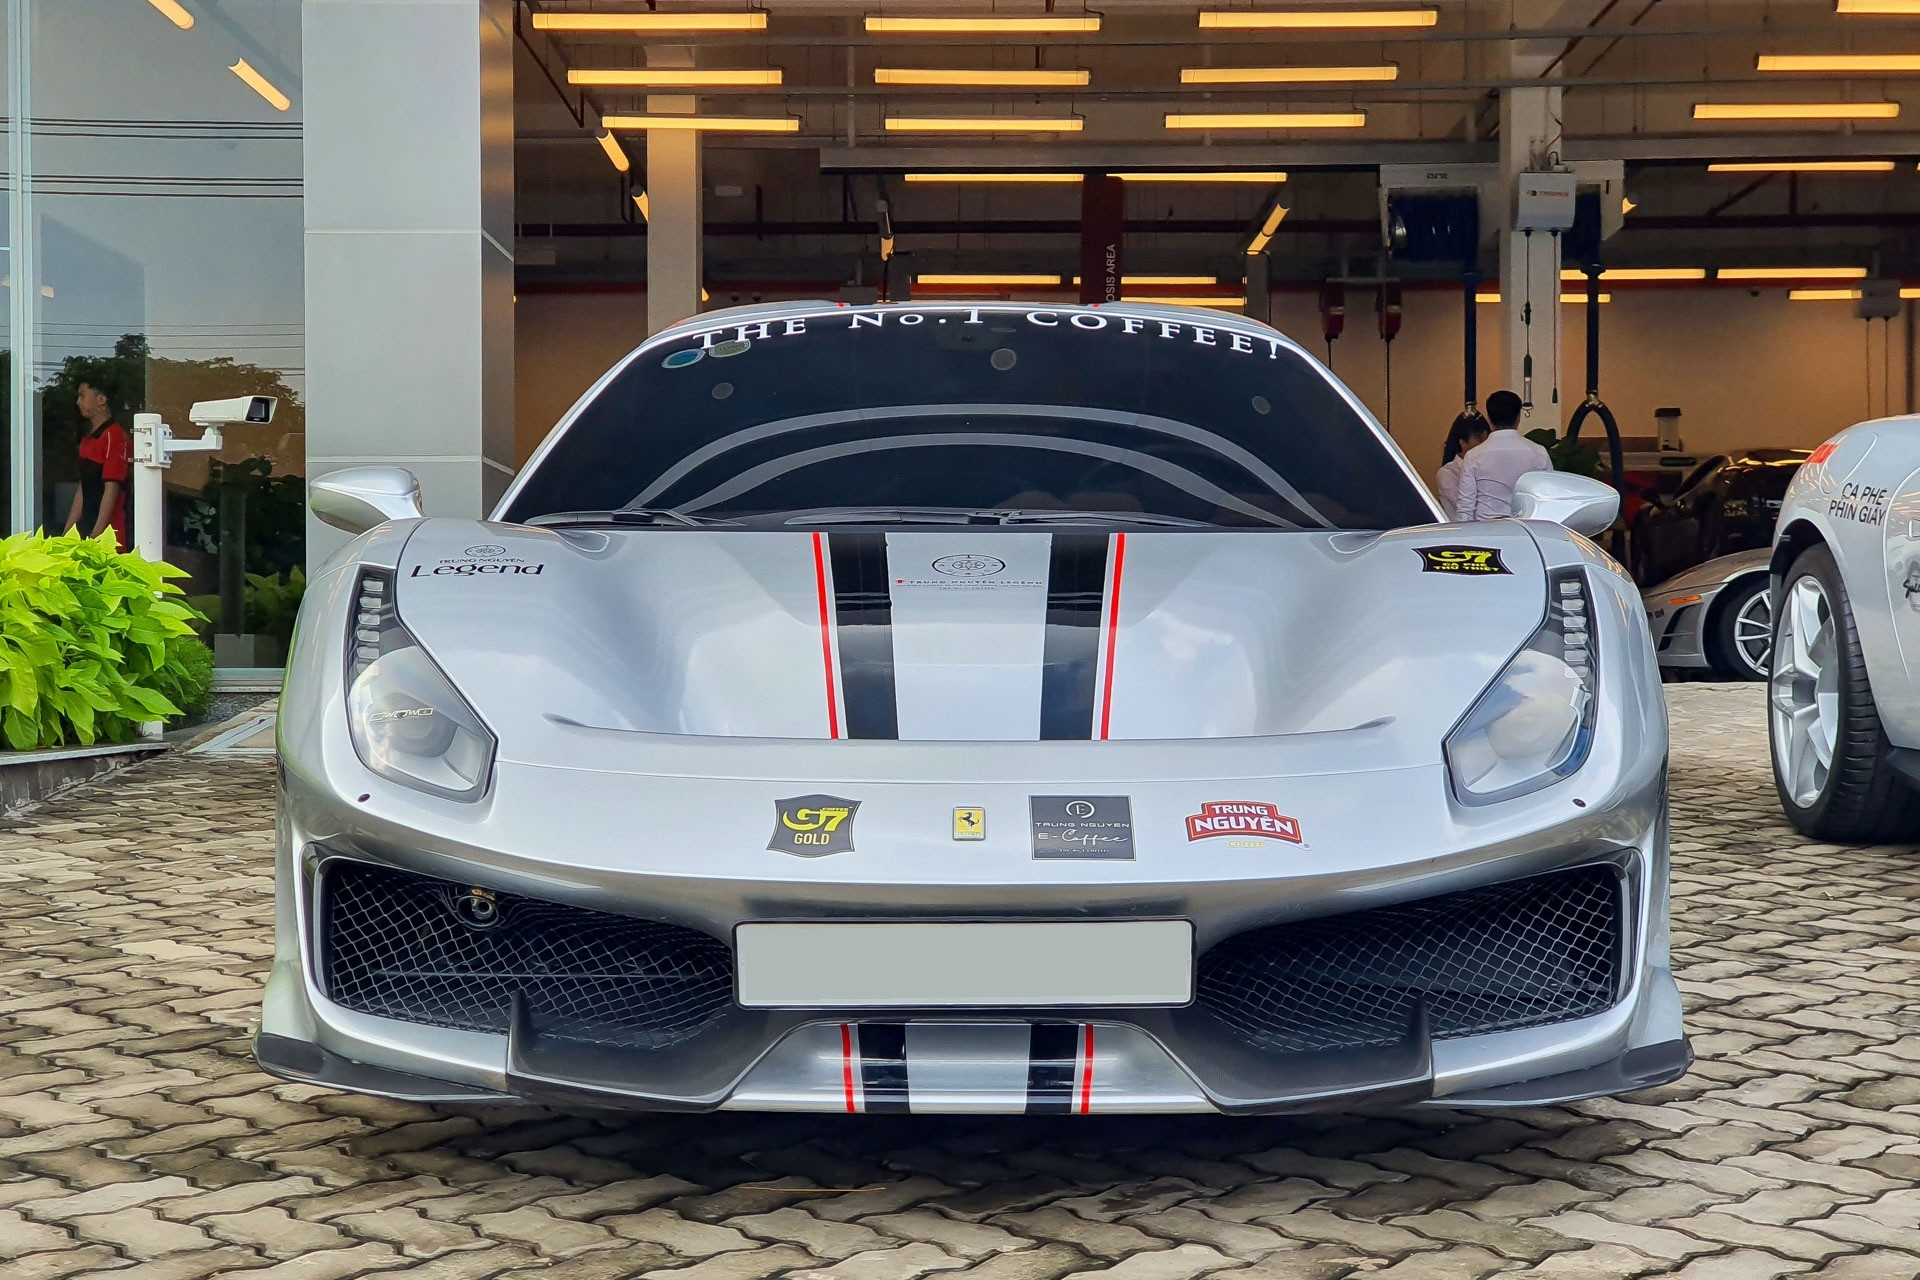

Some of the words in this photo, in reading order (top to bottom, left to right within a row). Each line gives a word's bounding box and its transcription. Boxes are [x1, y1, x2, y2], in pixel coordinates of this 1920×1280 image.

[1106, 244, 1115, 274] AREA
[693, 318, 806, 350] THE
[848, 309, 984, 329] No.1
[1026, 311, 1278, 360] COFFEE!
[1828, 499, 1858, 521] PHIN
[1427, 551, 1493, 563] G7
[410, 563, 545, 578] Legend
[1211, 804, 1269, 815] TRUNG
[782, 808, 849, 832] G7
[1194, 815, 1294, 835] NGUYÊN
[793, 833, 830, 845] GOLD
